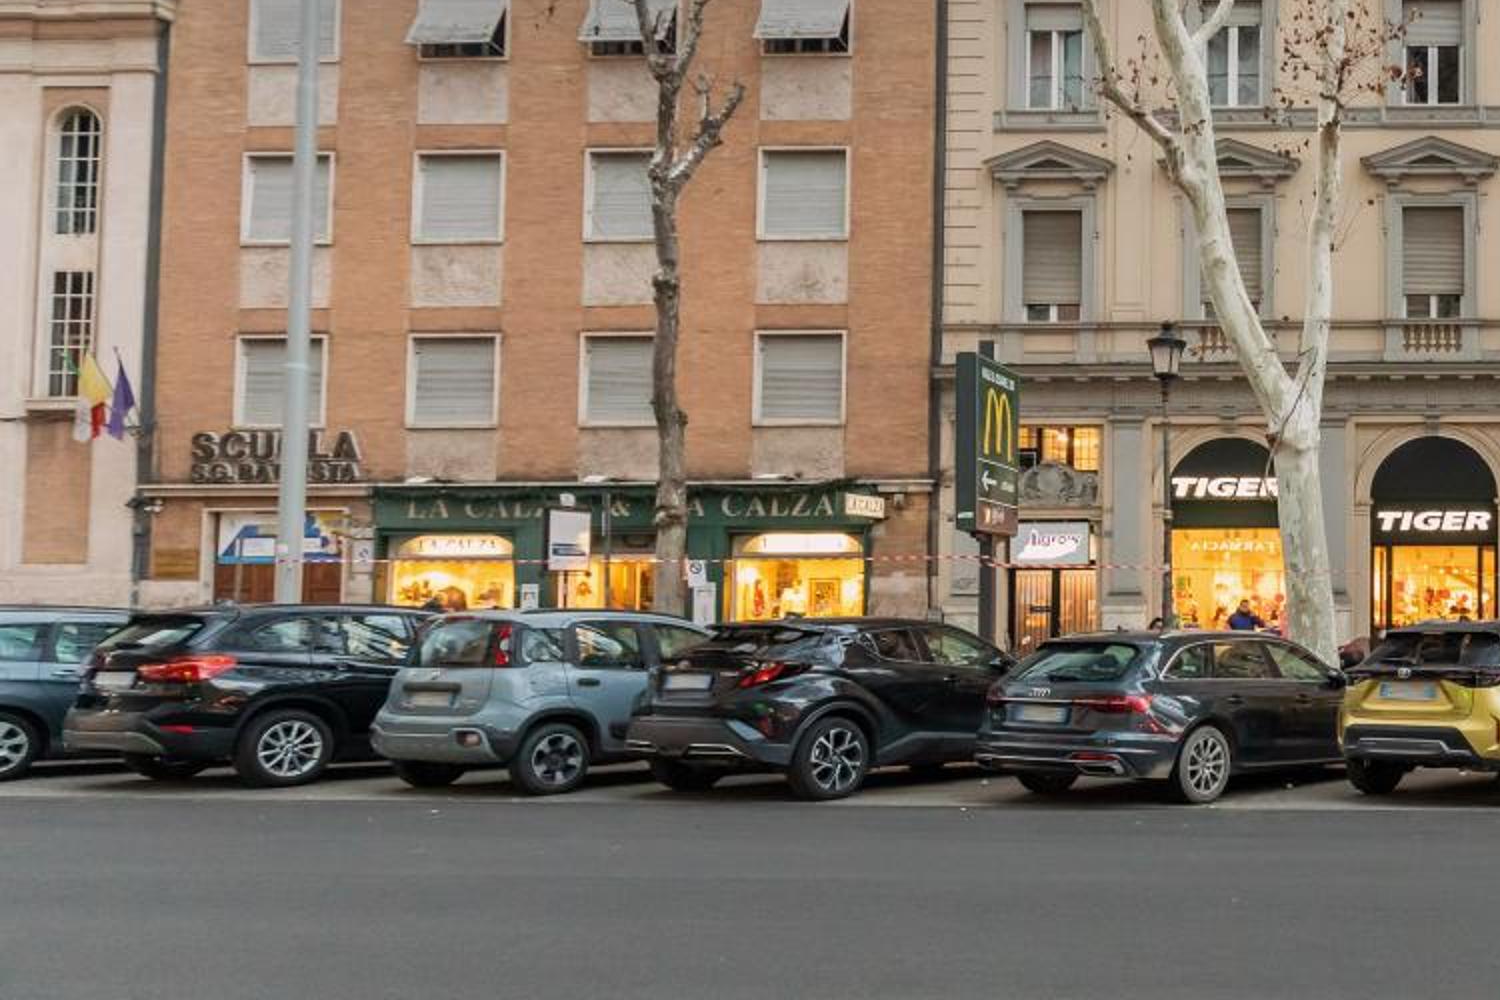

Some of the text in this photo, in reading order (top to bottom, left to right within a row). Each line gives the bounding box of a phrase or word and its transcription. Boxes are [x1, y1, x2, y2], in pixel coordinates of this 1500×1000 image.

[191, 431, 361, 460] SCULA
[406, 498, 449, 519] LA
[464, 498, 544, 519] CALZ
[611, 500, 631, 517] &
[720, 494, 833, 517] CALZA
[1376, 511, 1492, 531] TIGER
